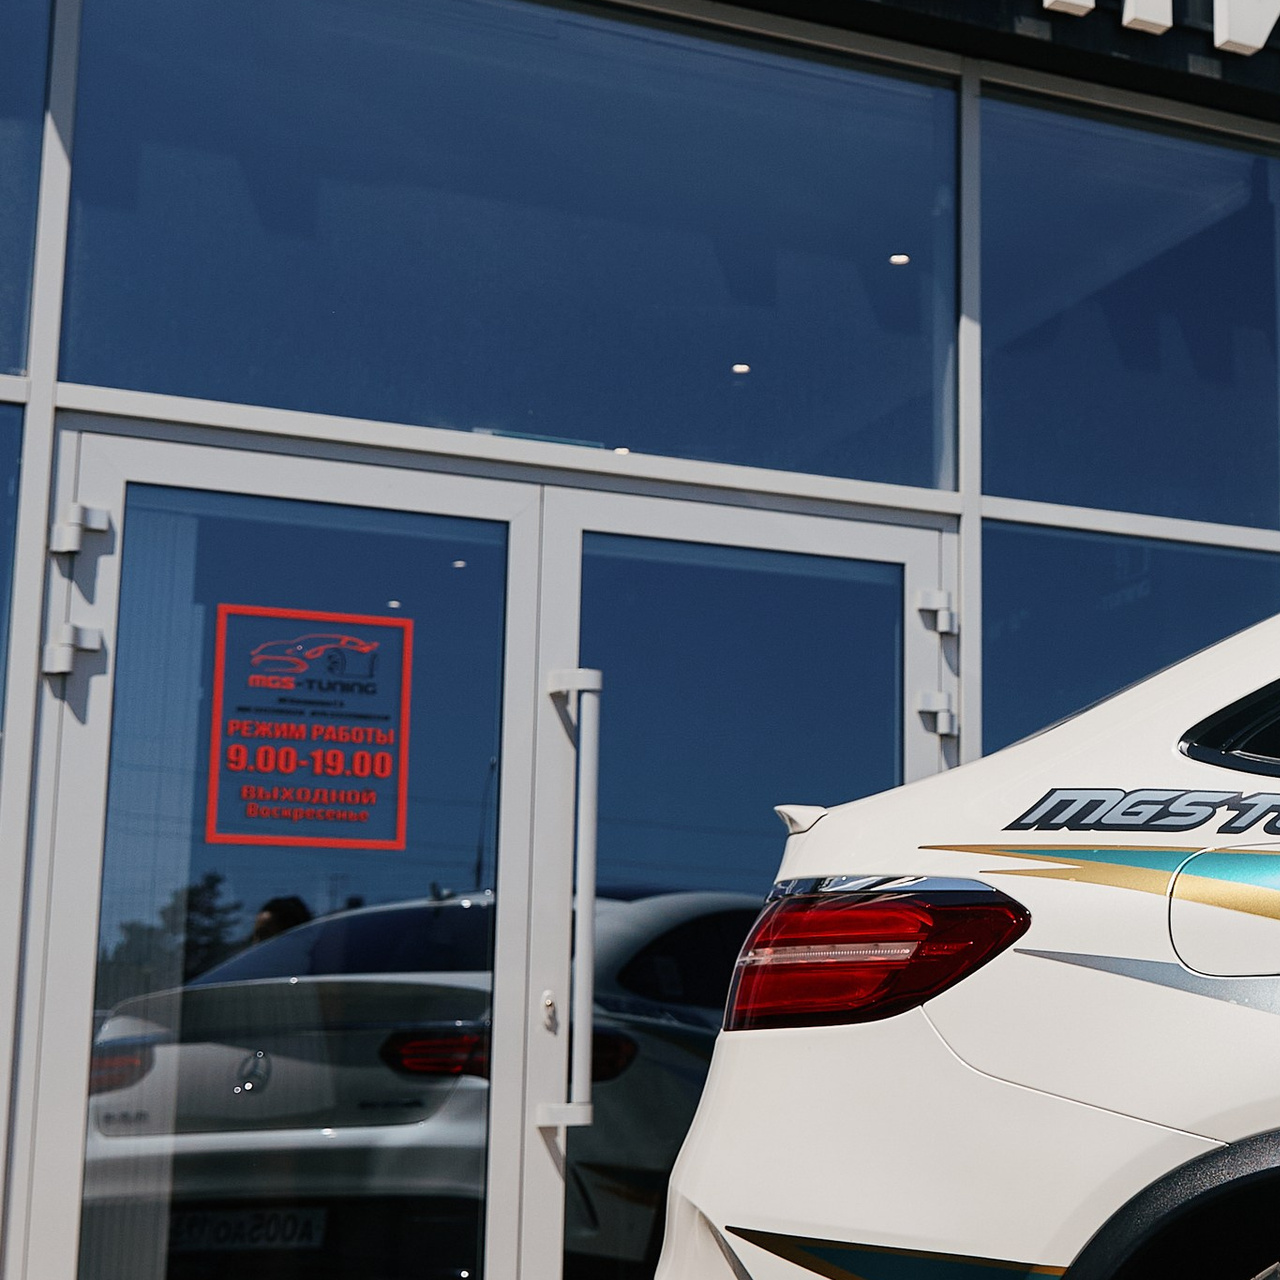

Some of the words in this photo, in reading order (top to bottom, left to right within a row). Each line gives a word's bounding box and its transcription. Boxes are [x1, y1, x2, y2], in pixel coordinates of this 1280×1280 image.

[227, 720, 305, 740] РЕЖИМ
[311, 725, 394, 745] РАБОТЫ
[226, 743, 392, 777] 9.00-19.00
[241, 784, 377, 805] ВЫХОДНОЙ
[246, 803, 369, 823] Воскресенье
